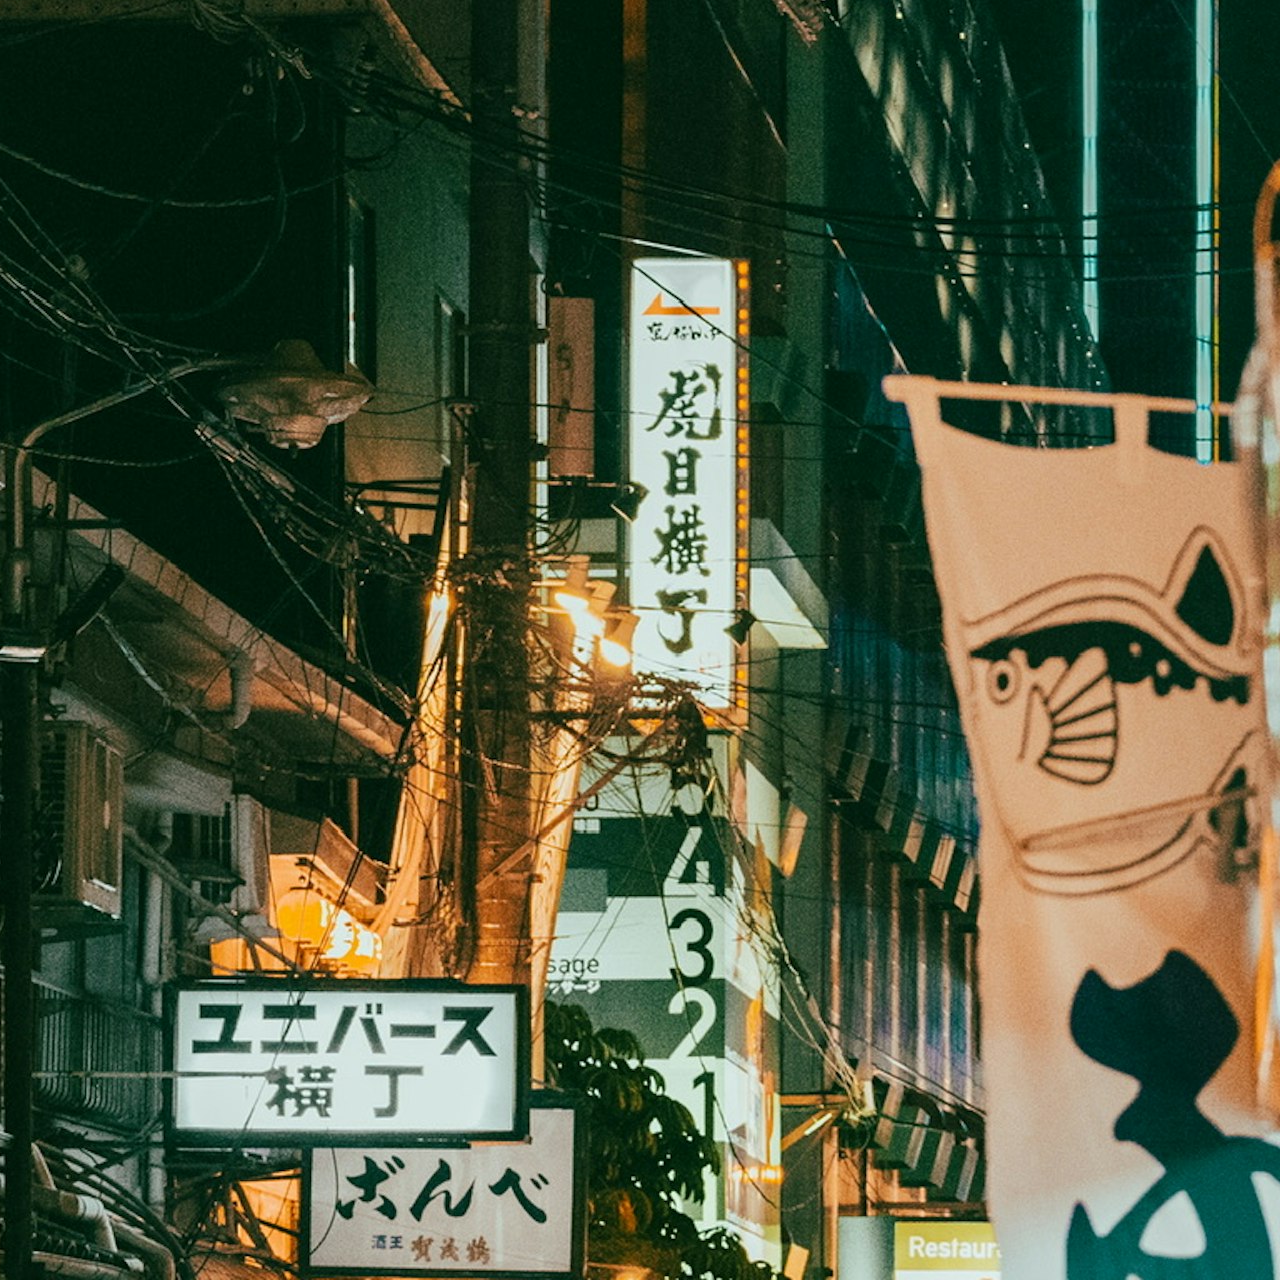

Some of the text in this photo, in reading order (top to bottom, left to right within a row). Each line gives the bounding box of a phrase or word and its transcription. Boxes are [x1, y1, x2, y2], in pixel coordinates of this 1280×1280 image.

[663, 826, 716, 896] 4
[668, 907, 715, 987] 3
[192, 1003, 498, 1057] ユニバース
[668, 987, 717, 1059] 2
[266, 1065, 424, 1118] 横丁
[693, 1072, 716, 1141] 1
